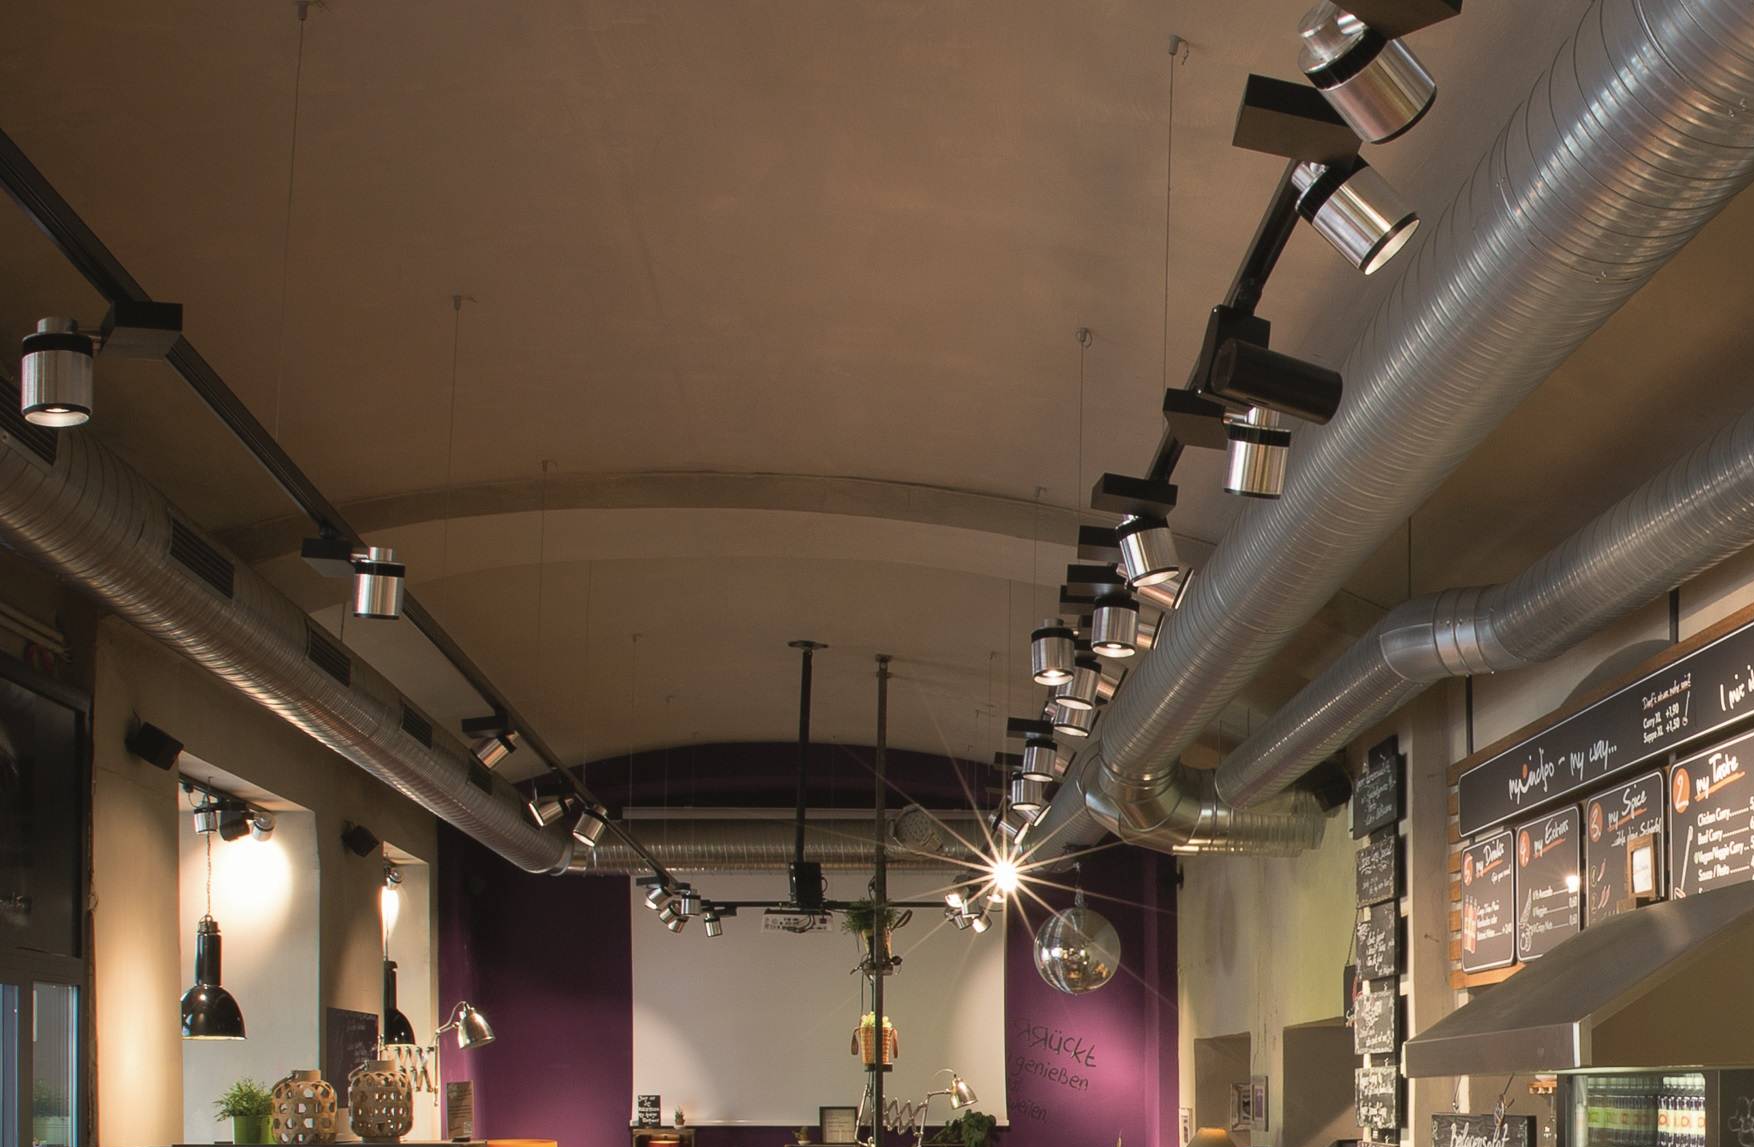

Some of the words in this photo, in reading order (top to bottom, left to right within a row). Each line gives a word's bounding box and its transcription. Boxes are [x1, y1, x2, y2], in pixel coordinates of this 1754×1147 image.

[1570, 752, 1585, 781] my
[1695, 775, 1710, 799] my
[1708, 752, 1739, 784] Taste
[1621, 784, 1648, 820] Spice
